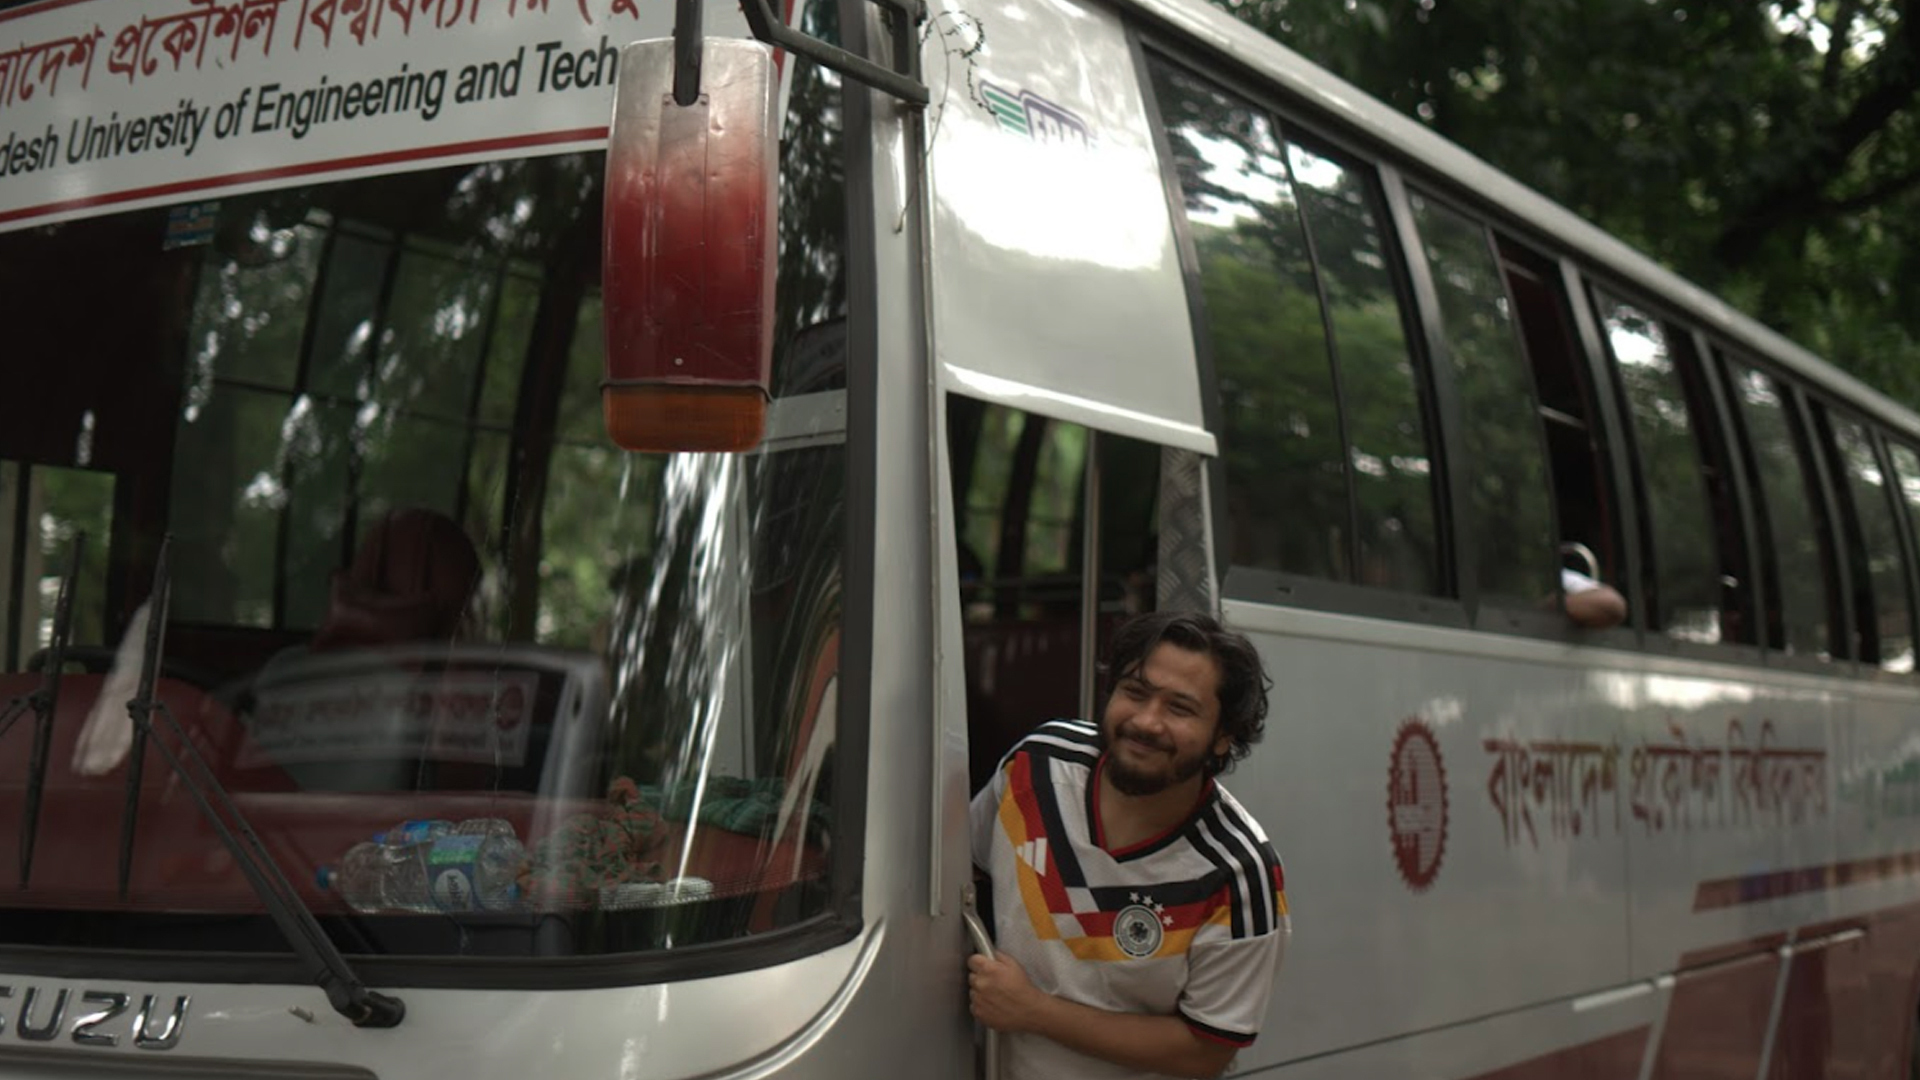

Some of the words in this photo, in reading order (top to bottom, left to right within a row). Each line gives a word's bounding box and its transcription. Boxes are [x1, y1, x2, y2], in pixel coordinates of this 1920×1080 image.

[66, 98, 210, 157] University
[214, 86, 252, 139] of
[251, 62, 448, 140] Engineering
[454, 45, 526, 104] and
[535, 34, 619, 93] Tech
[1482, 734, 1622, 850] বাংলাদেশ
